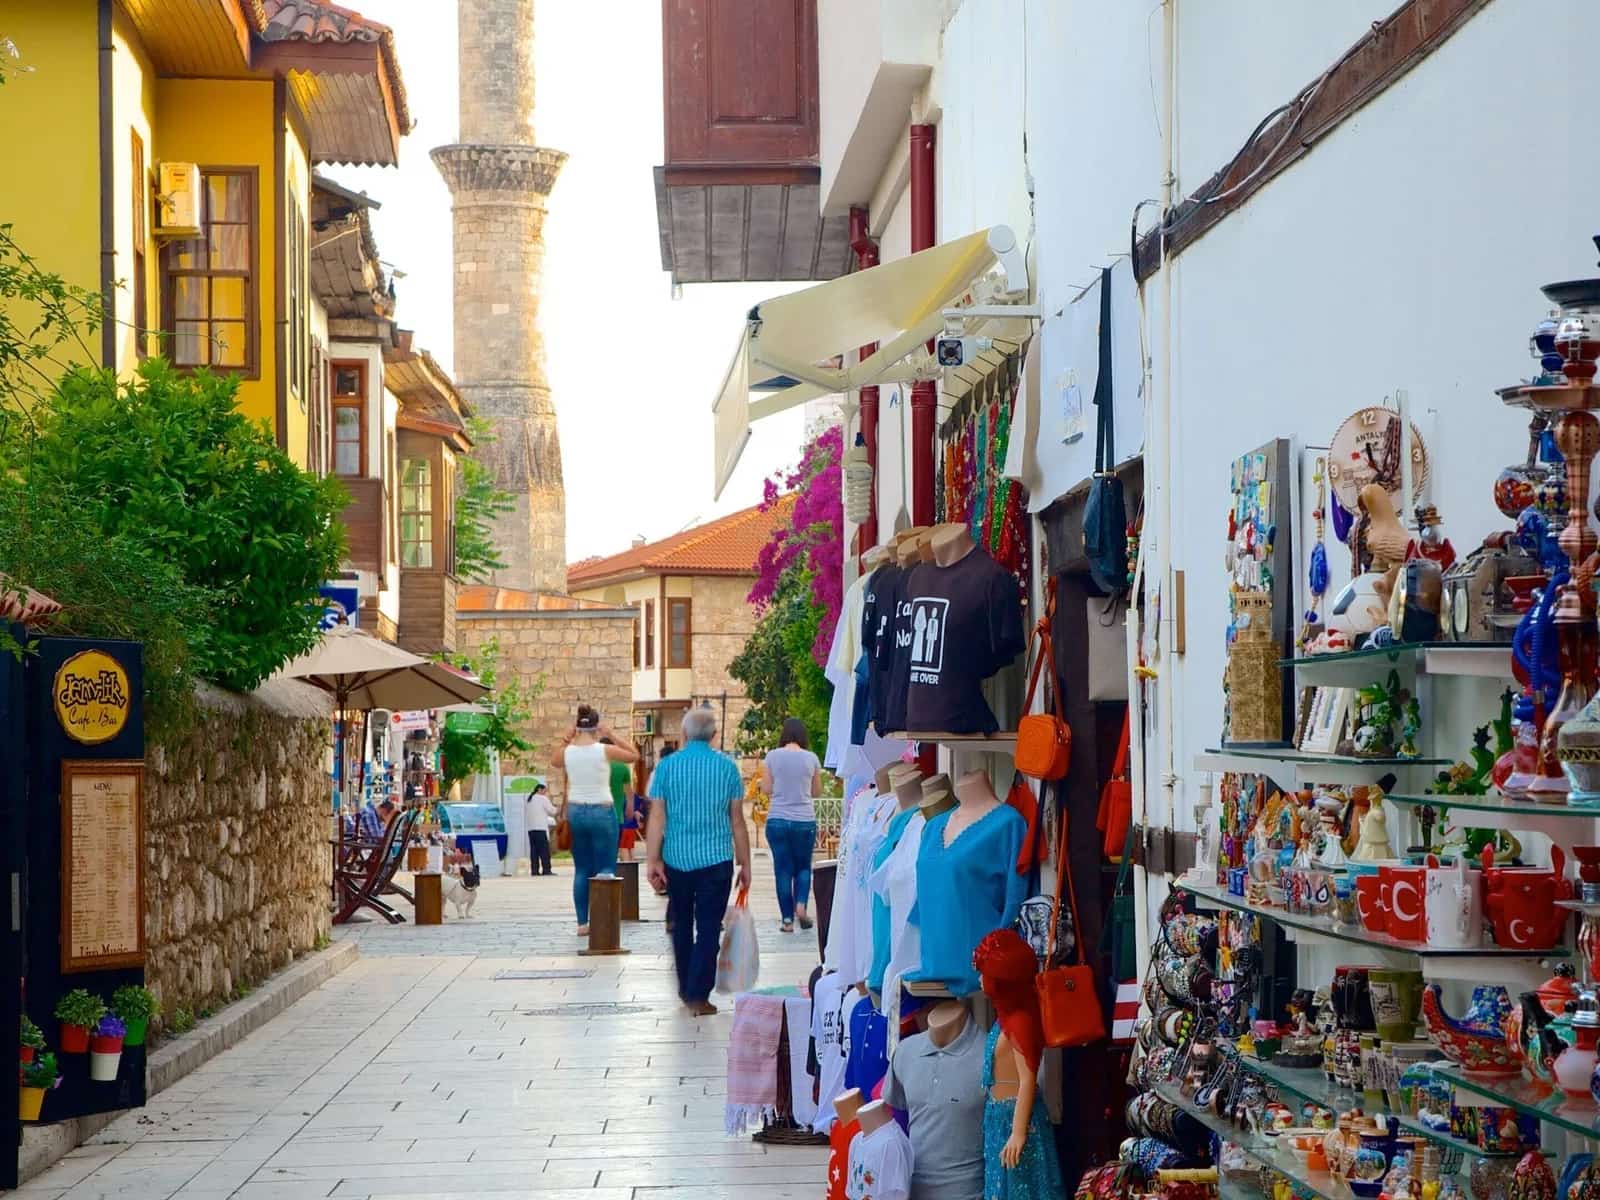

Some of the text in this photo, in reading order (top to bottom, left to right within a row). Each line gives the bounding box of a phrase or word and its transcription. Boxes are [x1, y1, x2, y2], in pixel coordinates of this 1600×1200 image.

[1361, 411, 1376, 426] 12
[1356, 431, 1387, 443] ANTALY
[1412, 448, 1421, 463] 3
[1330, 463, 1339, 478] 9
[919, 672, 939, 685] OVER
